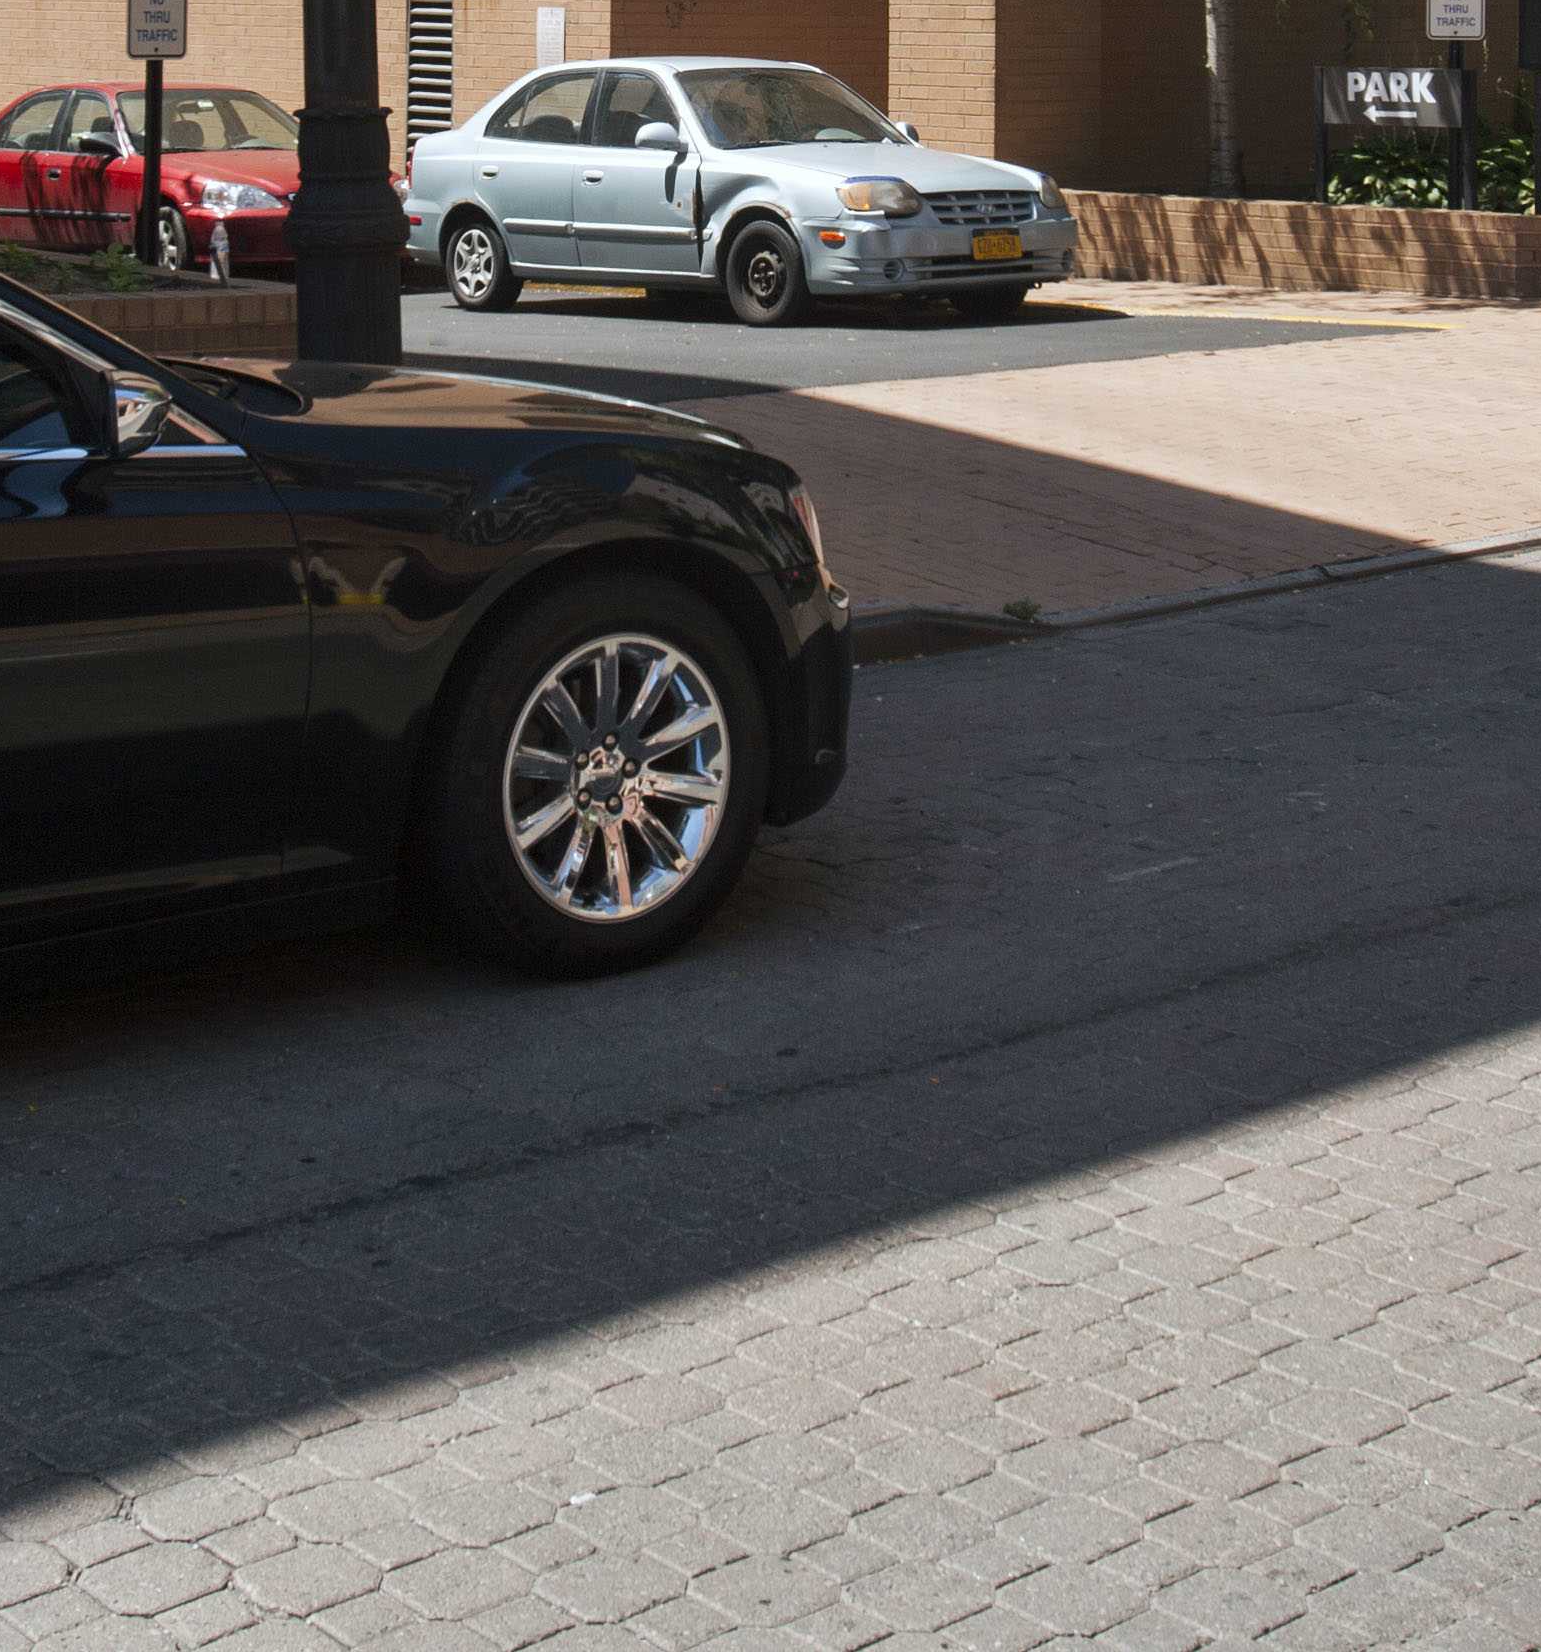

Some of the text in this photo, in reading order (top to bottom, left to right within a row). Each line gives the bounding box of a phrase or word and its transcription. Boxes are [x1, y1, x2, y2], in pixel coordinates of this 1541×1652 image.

[1443, 4, 1469, 14] THRU
[143, 10, 171, 24] THRU
[1436, 17, 1476, 27] TRAFFIC
[136, 28, 178, 42] TRAFFIC
[1347, 71, 1437, 104] PARK
